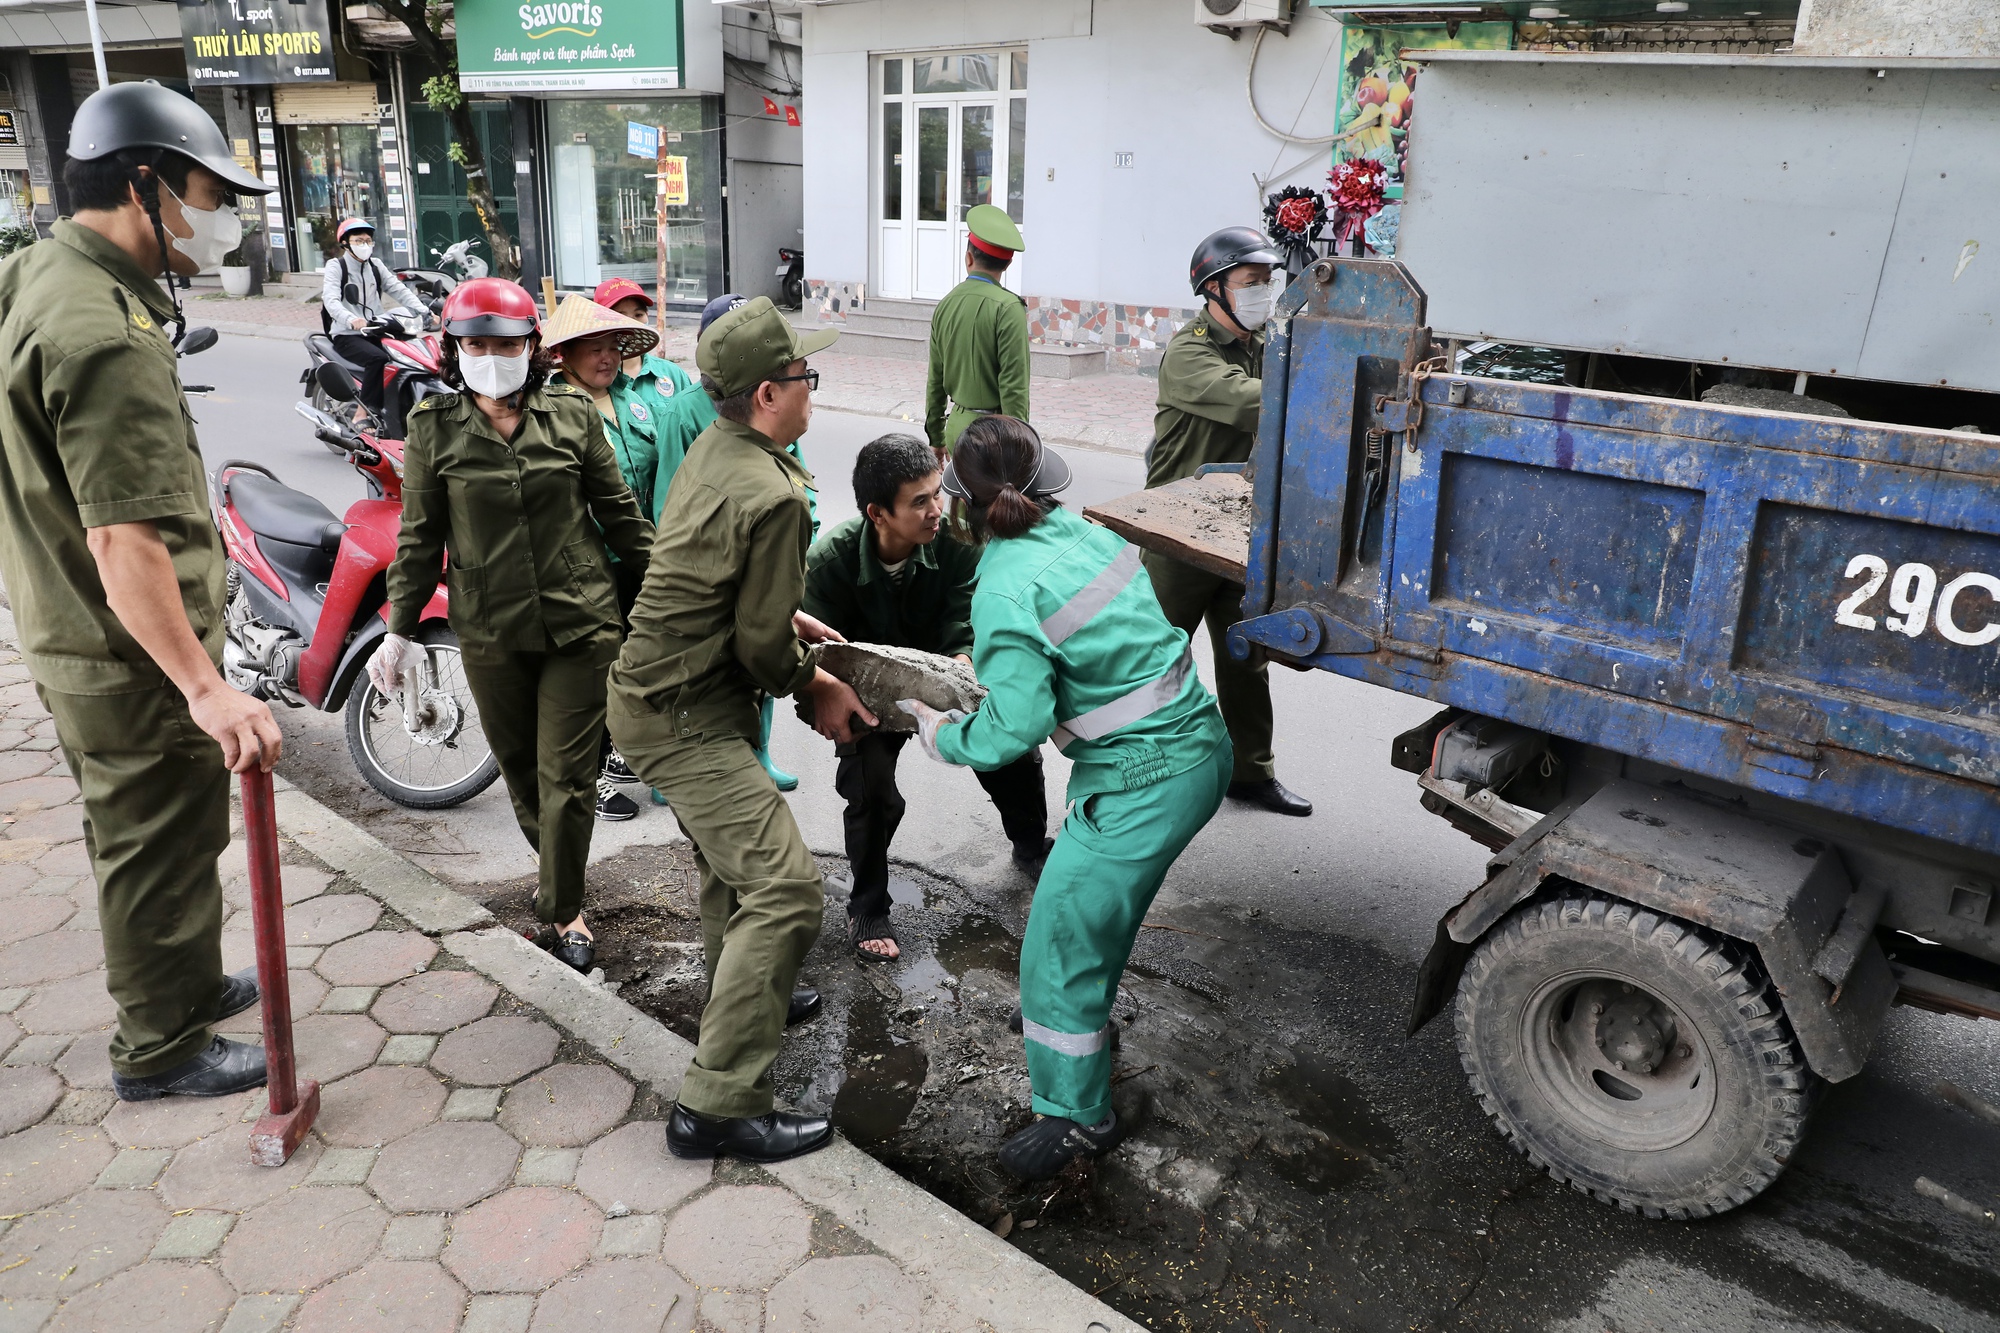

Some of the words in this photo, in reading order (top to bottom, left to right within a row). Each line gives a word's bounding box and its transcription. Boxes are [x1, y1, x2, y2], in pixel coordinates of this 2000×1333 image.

[246, 7, 273, 24] sport
[518, 0, 603, 30] Savoris
[233, 29, 261, 56] LÂN
[263, 31, 322, 56] SPORTS
[493, 47, 518, 62] Bánh
[521, 49, 541, 64] ngọt
[543, 47, 555, 61] và
[557, 46, 578, 63] thực
[580, 43, 608, 62] phẩm
[610, 43, 636, 62] Sạch
[474, 79, 484, 87] 111
[644, 132, 655, 147] 111
[1116, 154, 1132, 166] 113
[240, 195, 256, 209] 105
[1834, 553, 2000, 646] 29C
